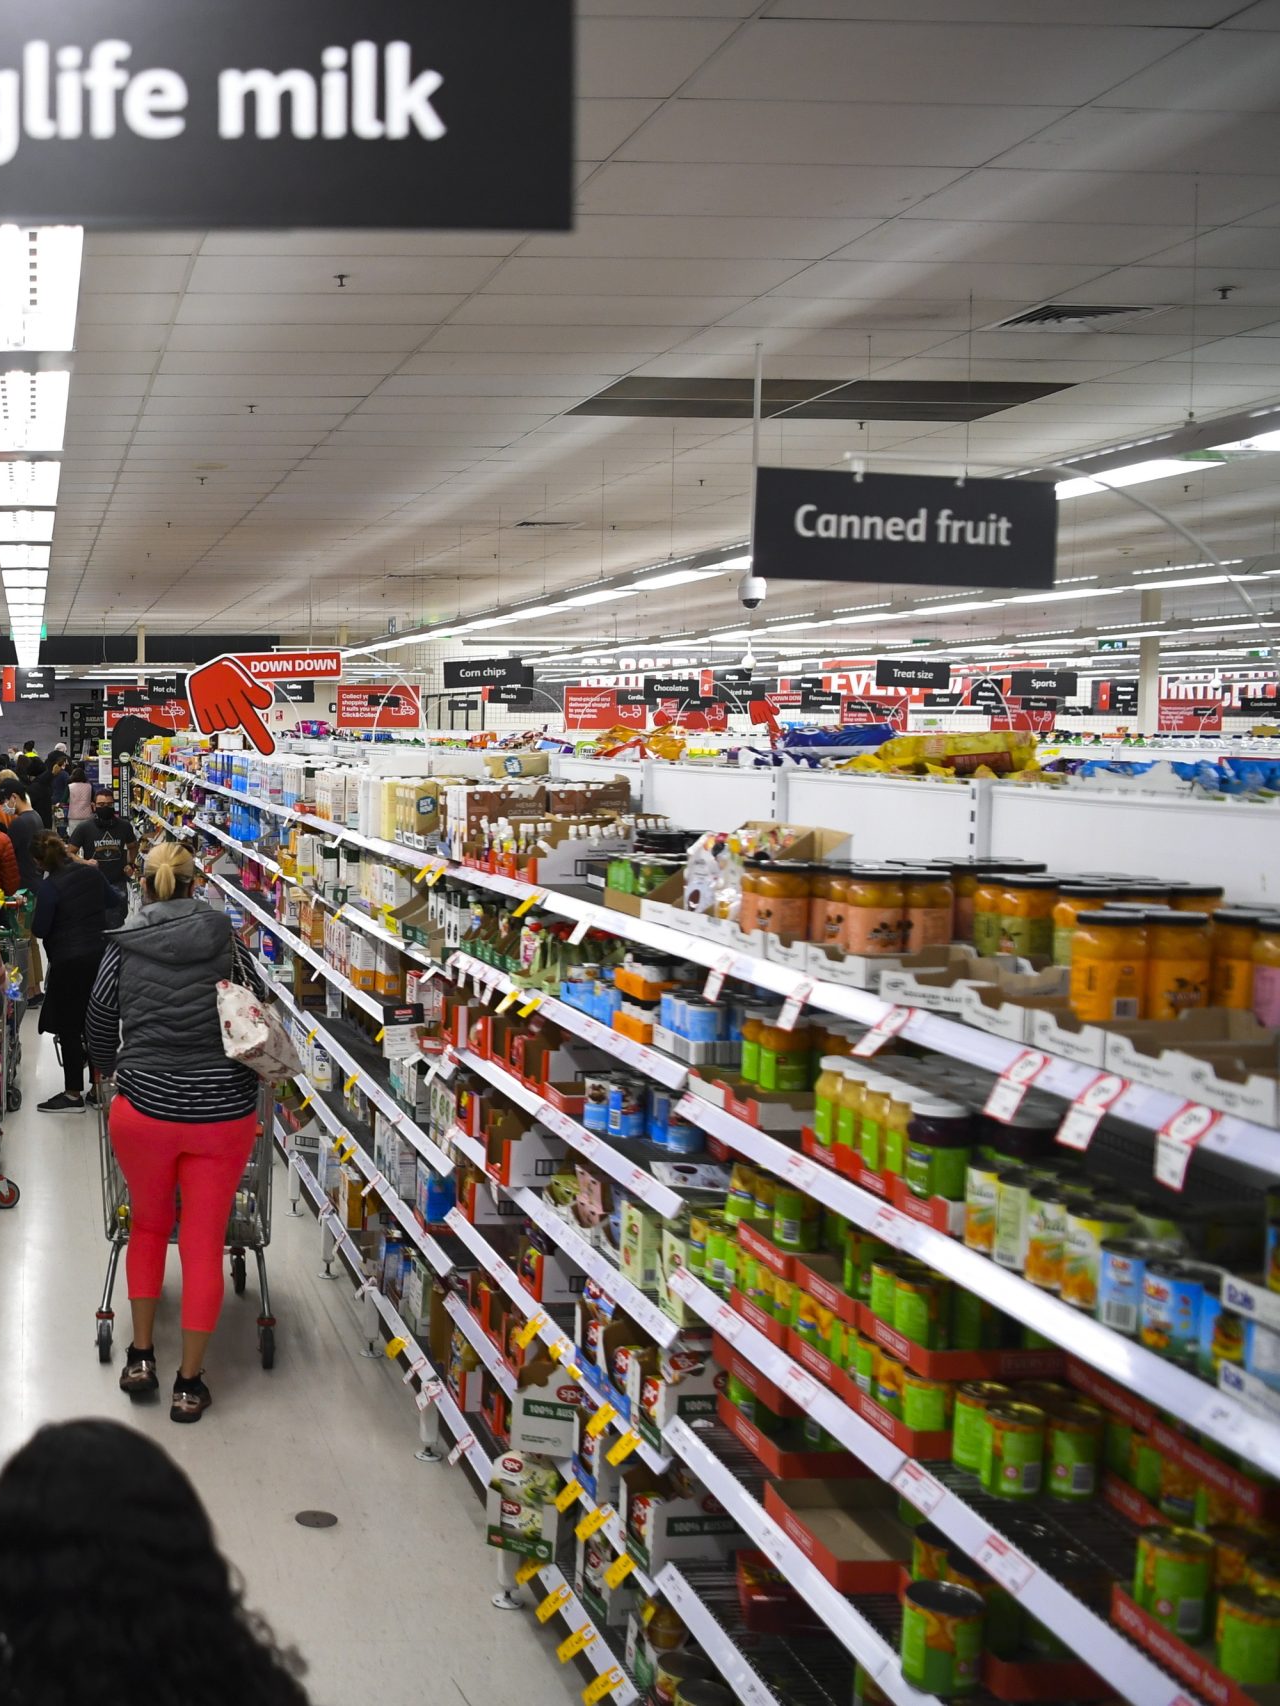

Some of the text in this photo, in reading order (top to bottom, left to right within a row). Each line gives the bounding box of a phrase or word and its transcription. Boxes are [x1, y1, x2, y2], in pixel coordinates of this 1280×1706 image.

[218, 40, 446, 141] milk
[794, 503, 1013, 547] Canned fruit
[250, 657, 337, 673] DOWN DOWN
[459, 667, 507, 679] Corn chips
[892, 669, 934, 680] Treat size
[6, 681, 12, 690] 3
[153, 685, 165, 693] Hot
[653, 683, 690, 693] Chocolates
[1031, 678, 1057, 689] Sports
[1144, 1278, 1169, 1303] Dole
[1227, 1284, 1255, 1311] Dole
[560, 1389, 582, 1401] sp
[528, 1404, 554, 1416] 100%
